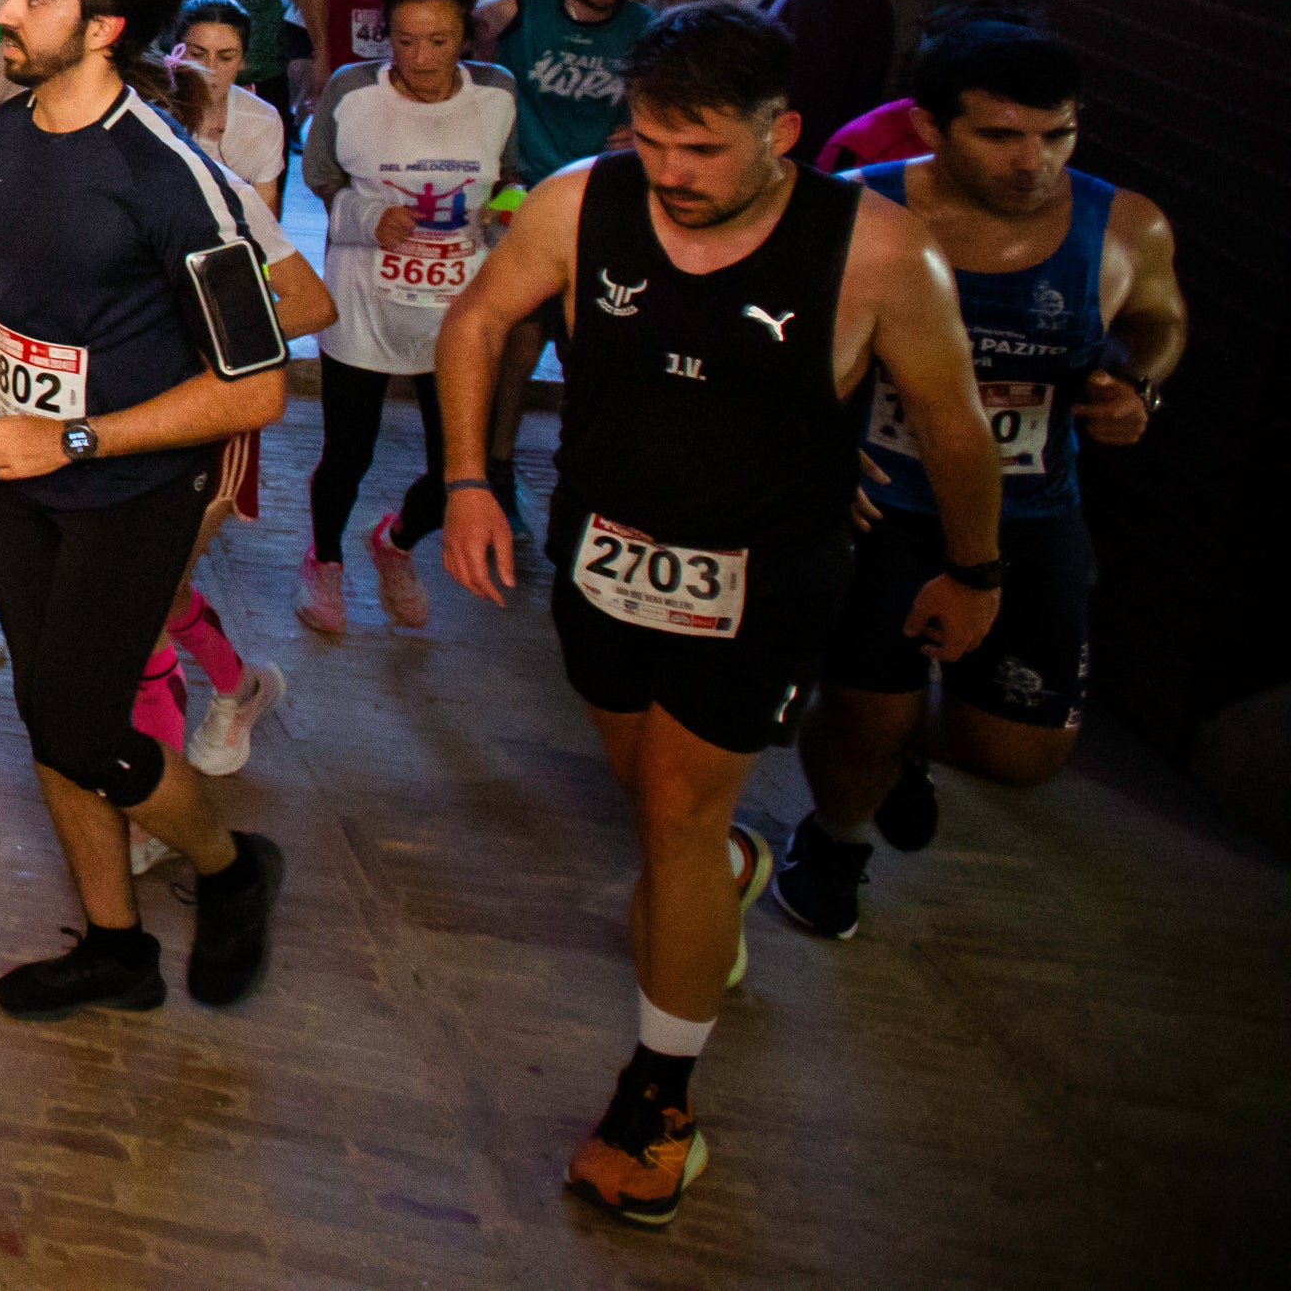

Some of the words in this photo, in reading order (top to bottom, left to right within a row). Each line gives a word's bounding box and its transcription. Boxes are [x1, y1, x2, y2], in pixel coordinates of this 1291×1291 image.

[380, 254, 466, 286] 5663
[980, 338, 1068, 355] PAZITO
[585, 535, 721, 601] 2703
